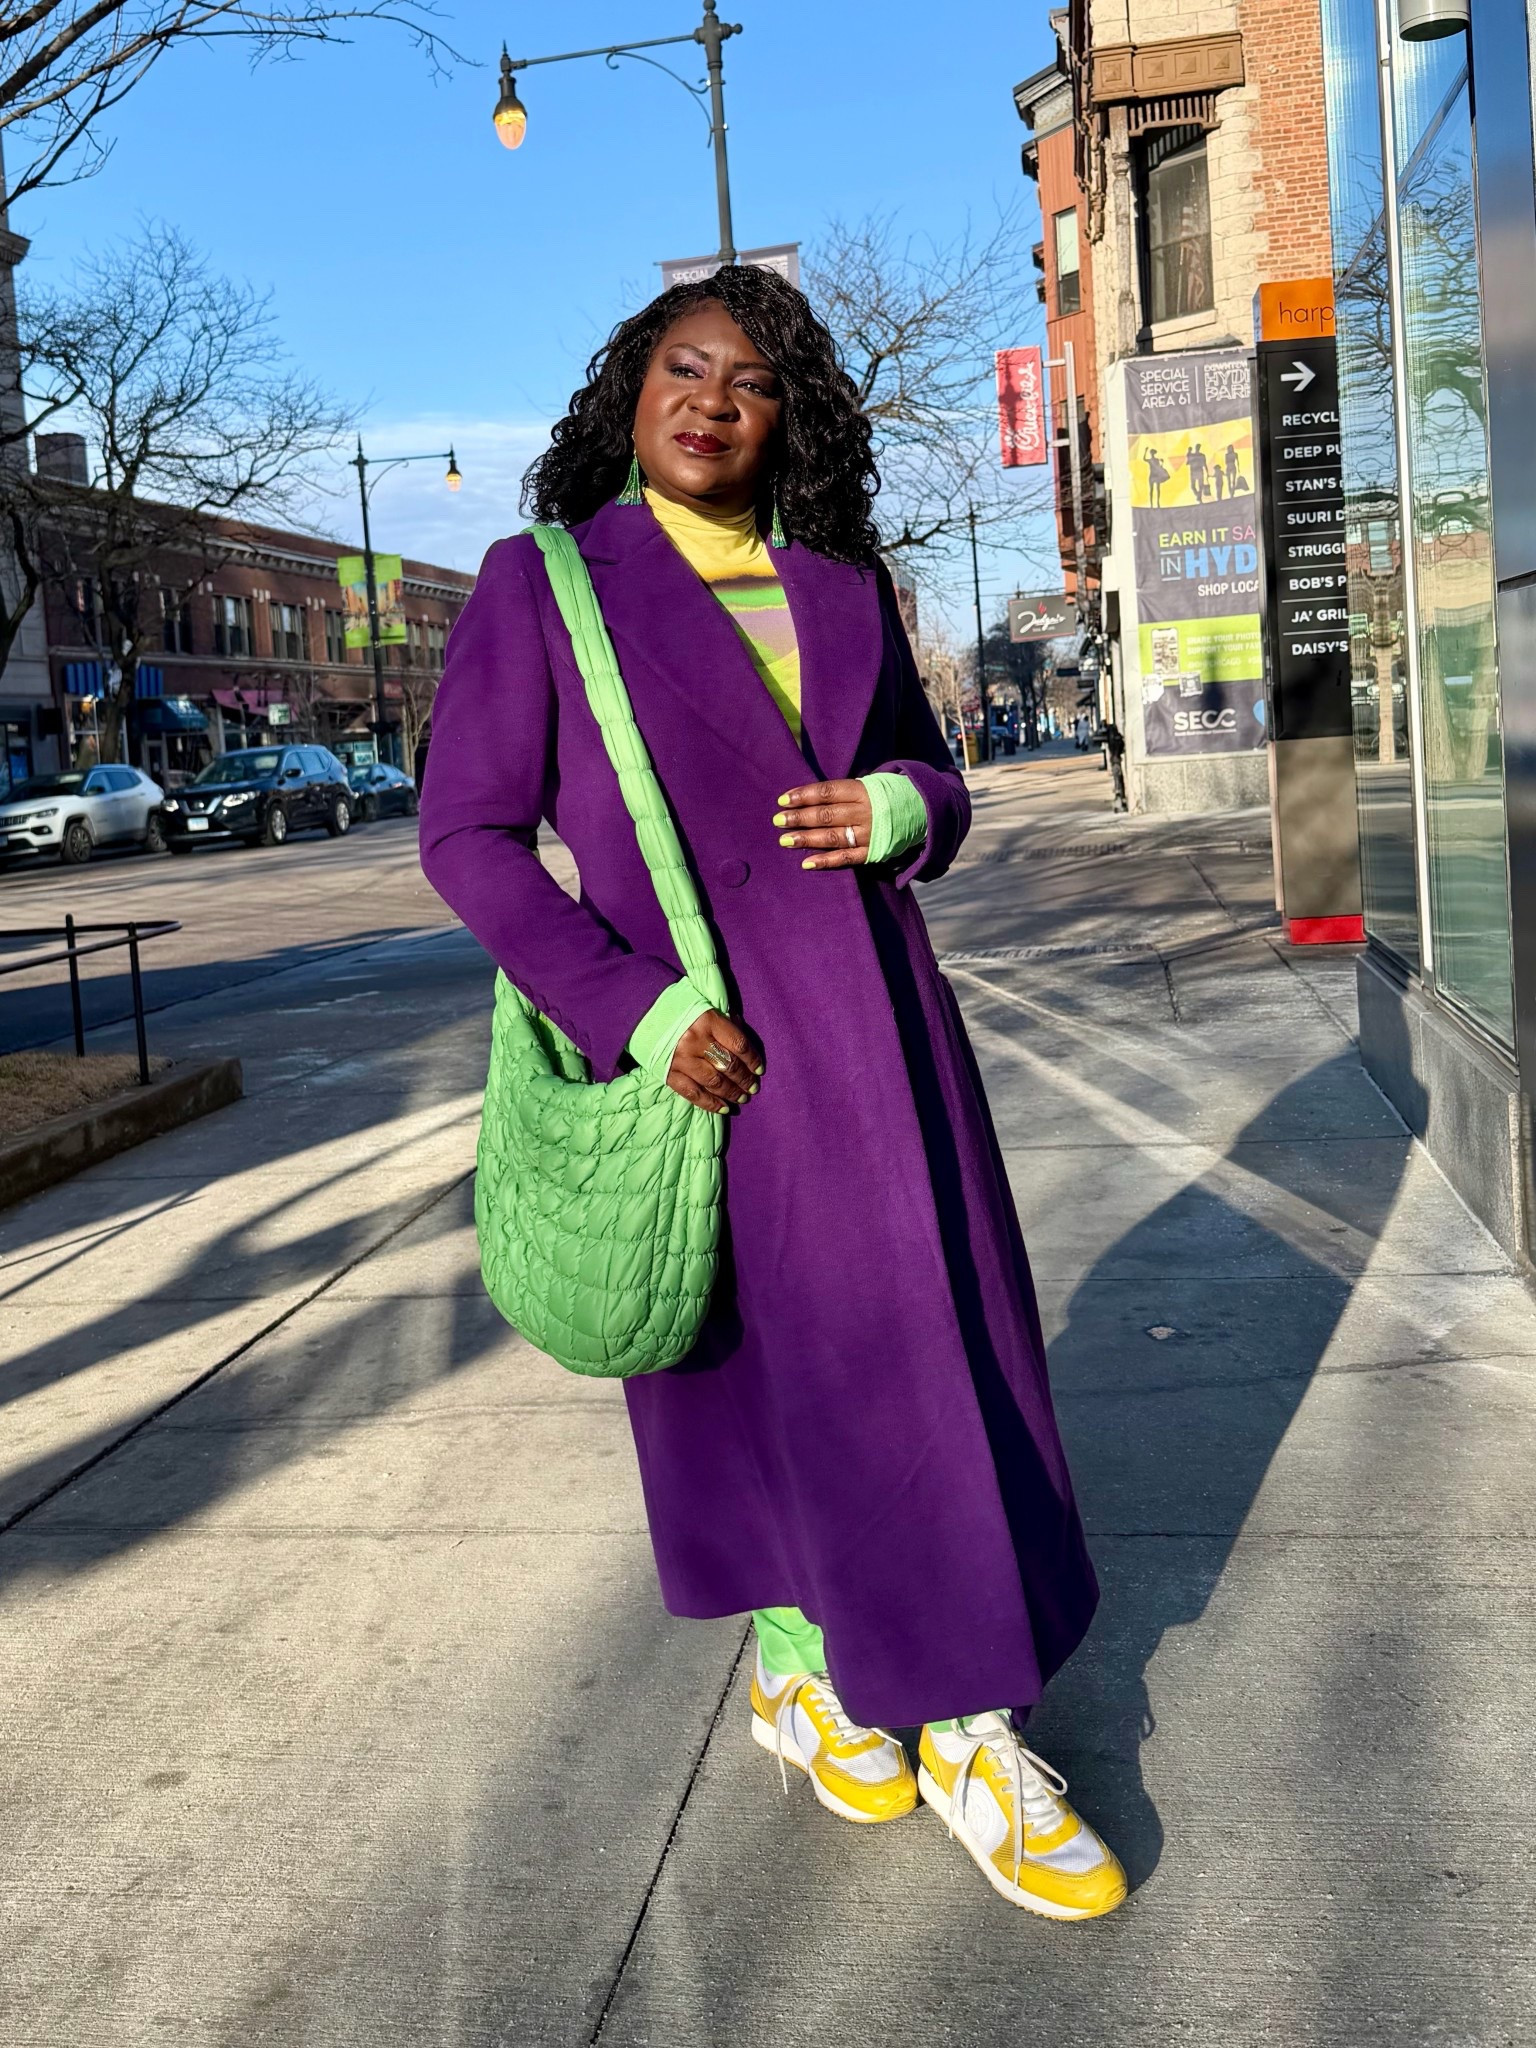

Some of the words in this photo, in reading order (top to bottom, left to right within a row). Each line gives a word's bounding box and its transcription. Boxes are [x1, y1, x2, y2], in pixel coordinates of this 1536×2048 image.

[1140, 367, 1189, 383] SPECIAL
[1140, 380, 1190, 397] SERVICE
[1141, 395, 1175, 409] AREA
[1178, 392, 1191, 405] 61
[1282, 411, 1339, 426] RECYCL
[1283, 445, 1322, 459] DEEP
[1285, 477, 1337, 492] STAN'S
[1287, 510, 1331, 525] SUURI
[1159, 529, 1206, 548] EARN
[1211, 527, 1229, 543] IT
[1232, 525, 1256, 541] SA
[1160, 556, 1181, 575] IN
[1184, 543, 1258, 579] HYD
[1197, 583, 1229, 597] SHOP
[1289, 575, 1334, 591] BOB'S
[1291, 610, 1313, 623] JA'
[1316, 607, 1350, 621] GRIL
[1291, 640, 1349, 656] DAISY'S
[1173, 708, 1237, 731] SECC
